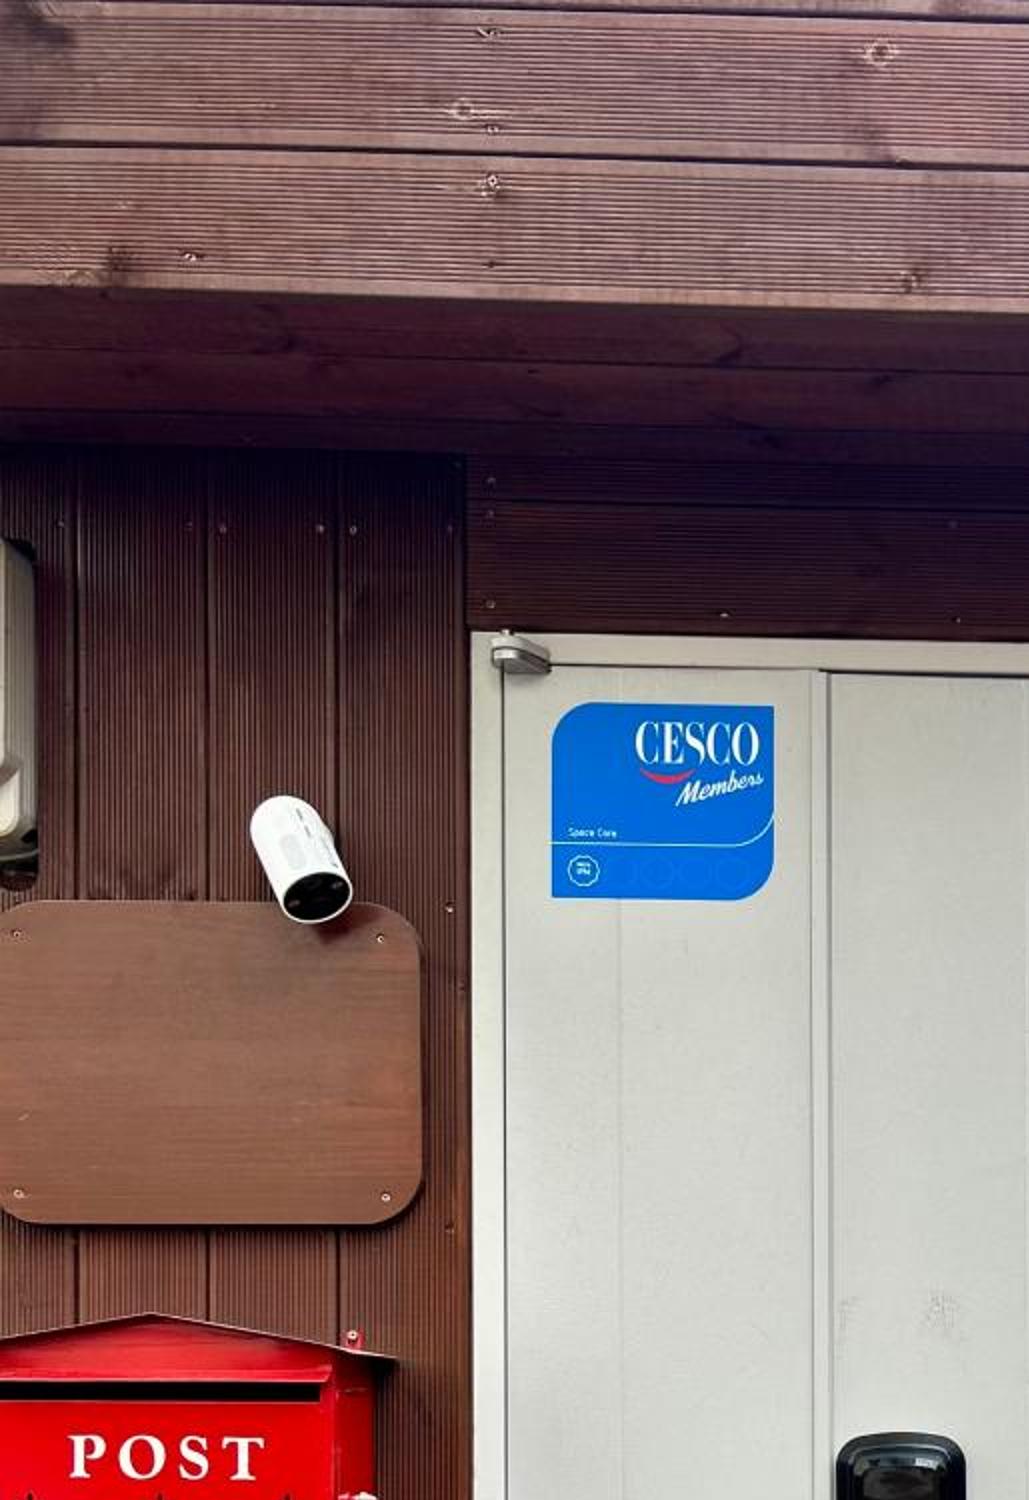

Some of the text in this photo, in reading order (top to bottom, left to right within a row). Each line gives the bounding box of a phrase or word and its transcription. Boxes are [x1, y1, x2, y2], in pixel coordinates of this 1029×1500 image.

[635, 720, 760, 765] CESCO
[675, 769, 764, 807] Members
[67, 1433, 265, 1481] POST
